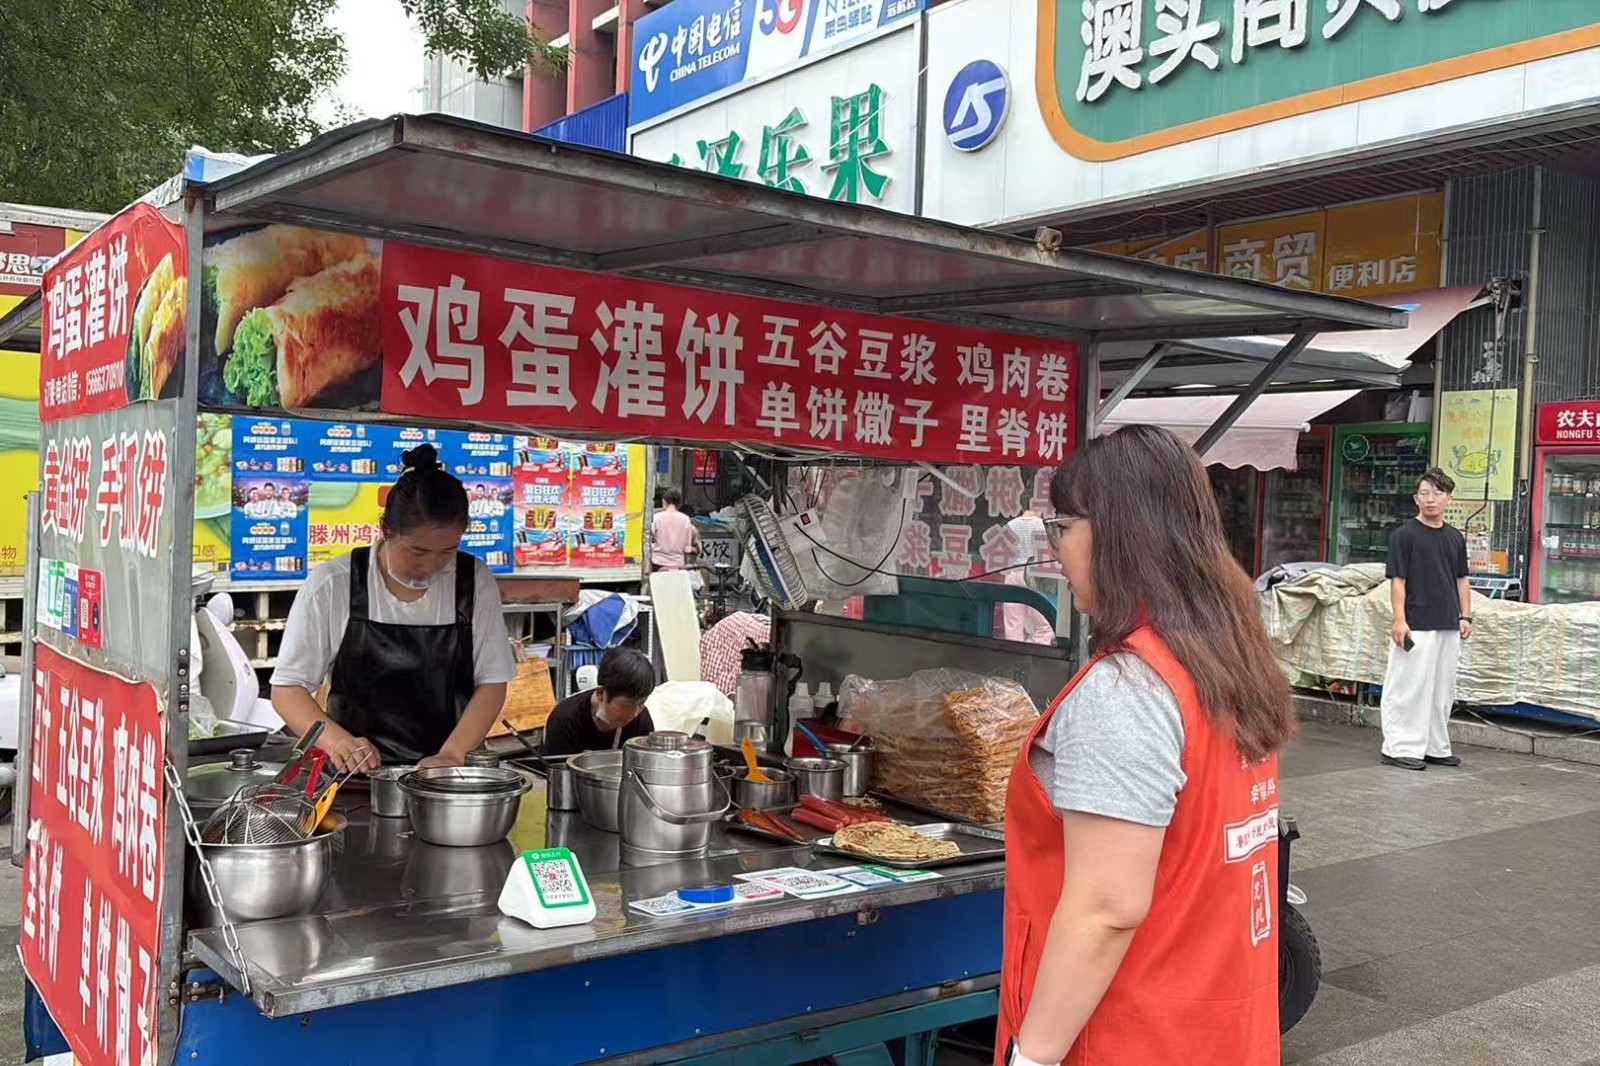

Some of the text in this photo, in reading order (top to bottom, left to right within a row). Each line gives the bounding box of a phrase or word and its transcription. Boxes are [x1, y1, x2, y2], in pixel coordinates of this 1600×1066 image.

[670, 0, 743, 66] 中国电信
[670, 42, 741, 82] CHINA TELECOM
[1076, 0, 1462, 101] 澳头商
[46, 233, 128, 361] 鸡蛋灌饼
[1328, 256, 1416, 290] 便利店
[397, 274, 745, 426] 鸡蛋灌饼
[757, 314, 1070, 402] 五谷豆浆 鸡肉卷
[755, 380, 1067, 461] 单饼馓子 里脊饼
[1556, 409, 1600, 428] 农夫
[1556, 429, 1593, 439] NONGFU
[41, 428, 167, 559] 黄金饼 手抓饼
[307, 523, 384, 545] 滕州鸿
[55, 684, 106, 846] 五谷豆浆
[112, 711, 157, 902] 鸡肉卷
